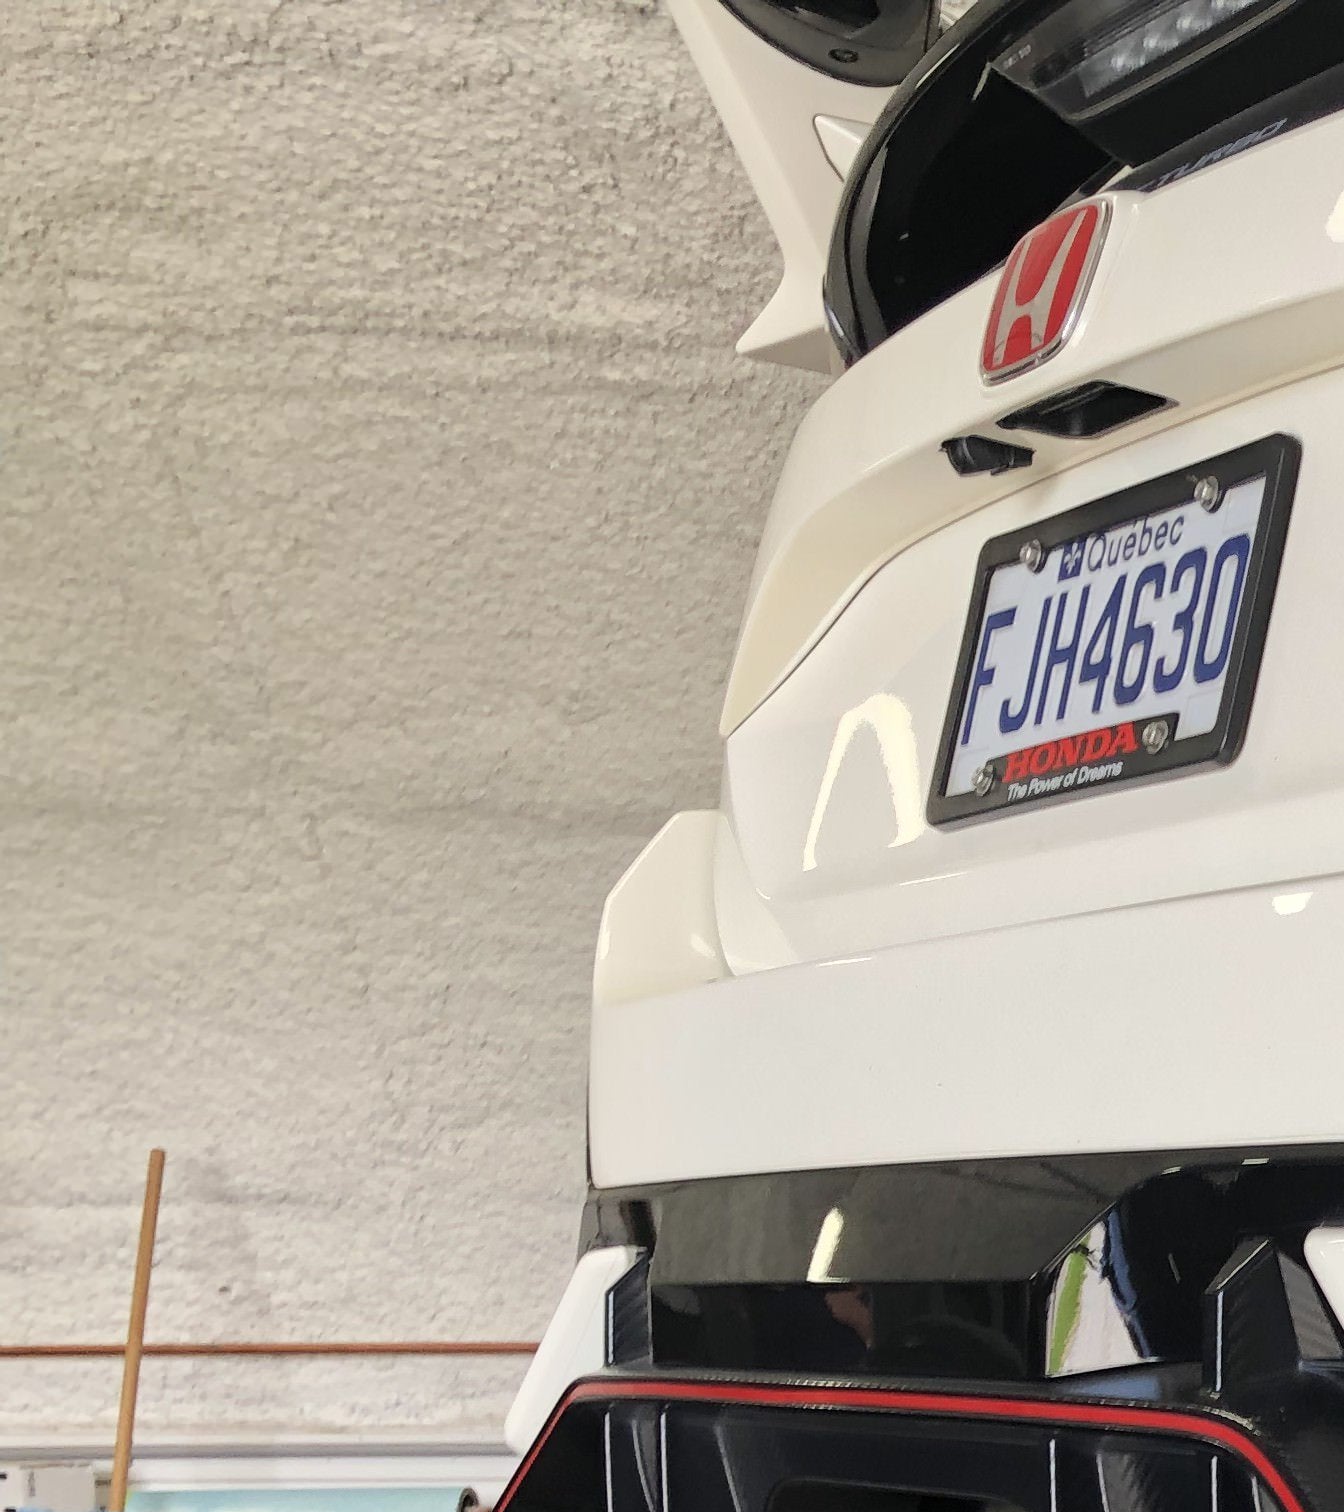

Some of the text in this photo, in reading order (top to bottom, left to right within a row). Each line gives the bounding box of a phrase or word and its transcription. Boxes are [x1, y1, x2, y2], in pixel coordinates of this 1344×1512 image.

[1087, 514, 1185, 572] Québec
[960, 532, 1252, 746] FJH4630
[1001, 720, 1139, 783] HONDA
[1007, 761, 1124, 801] The Power of Dreams
